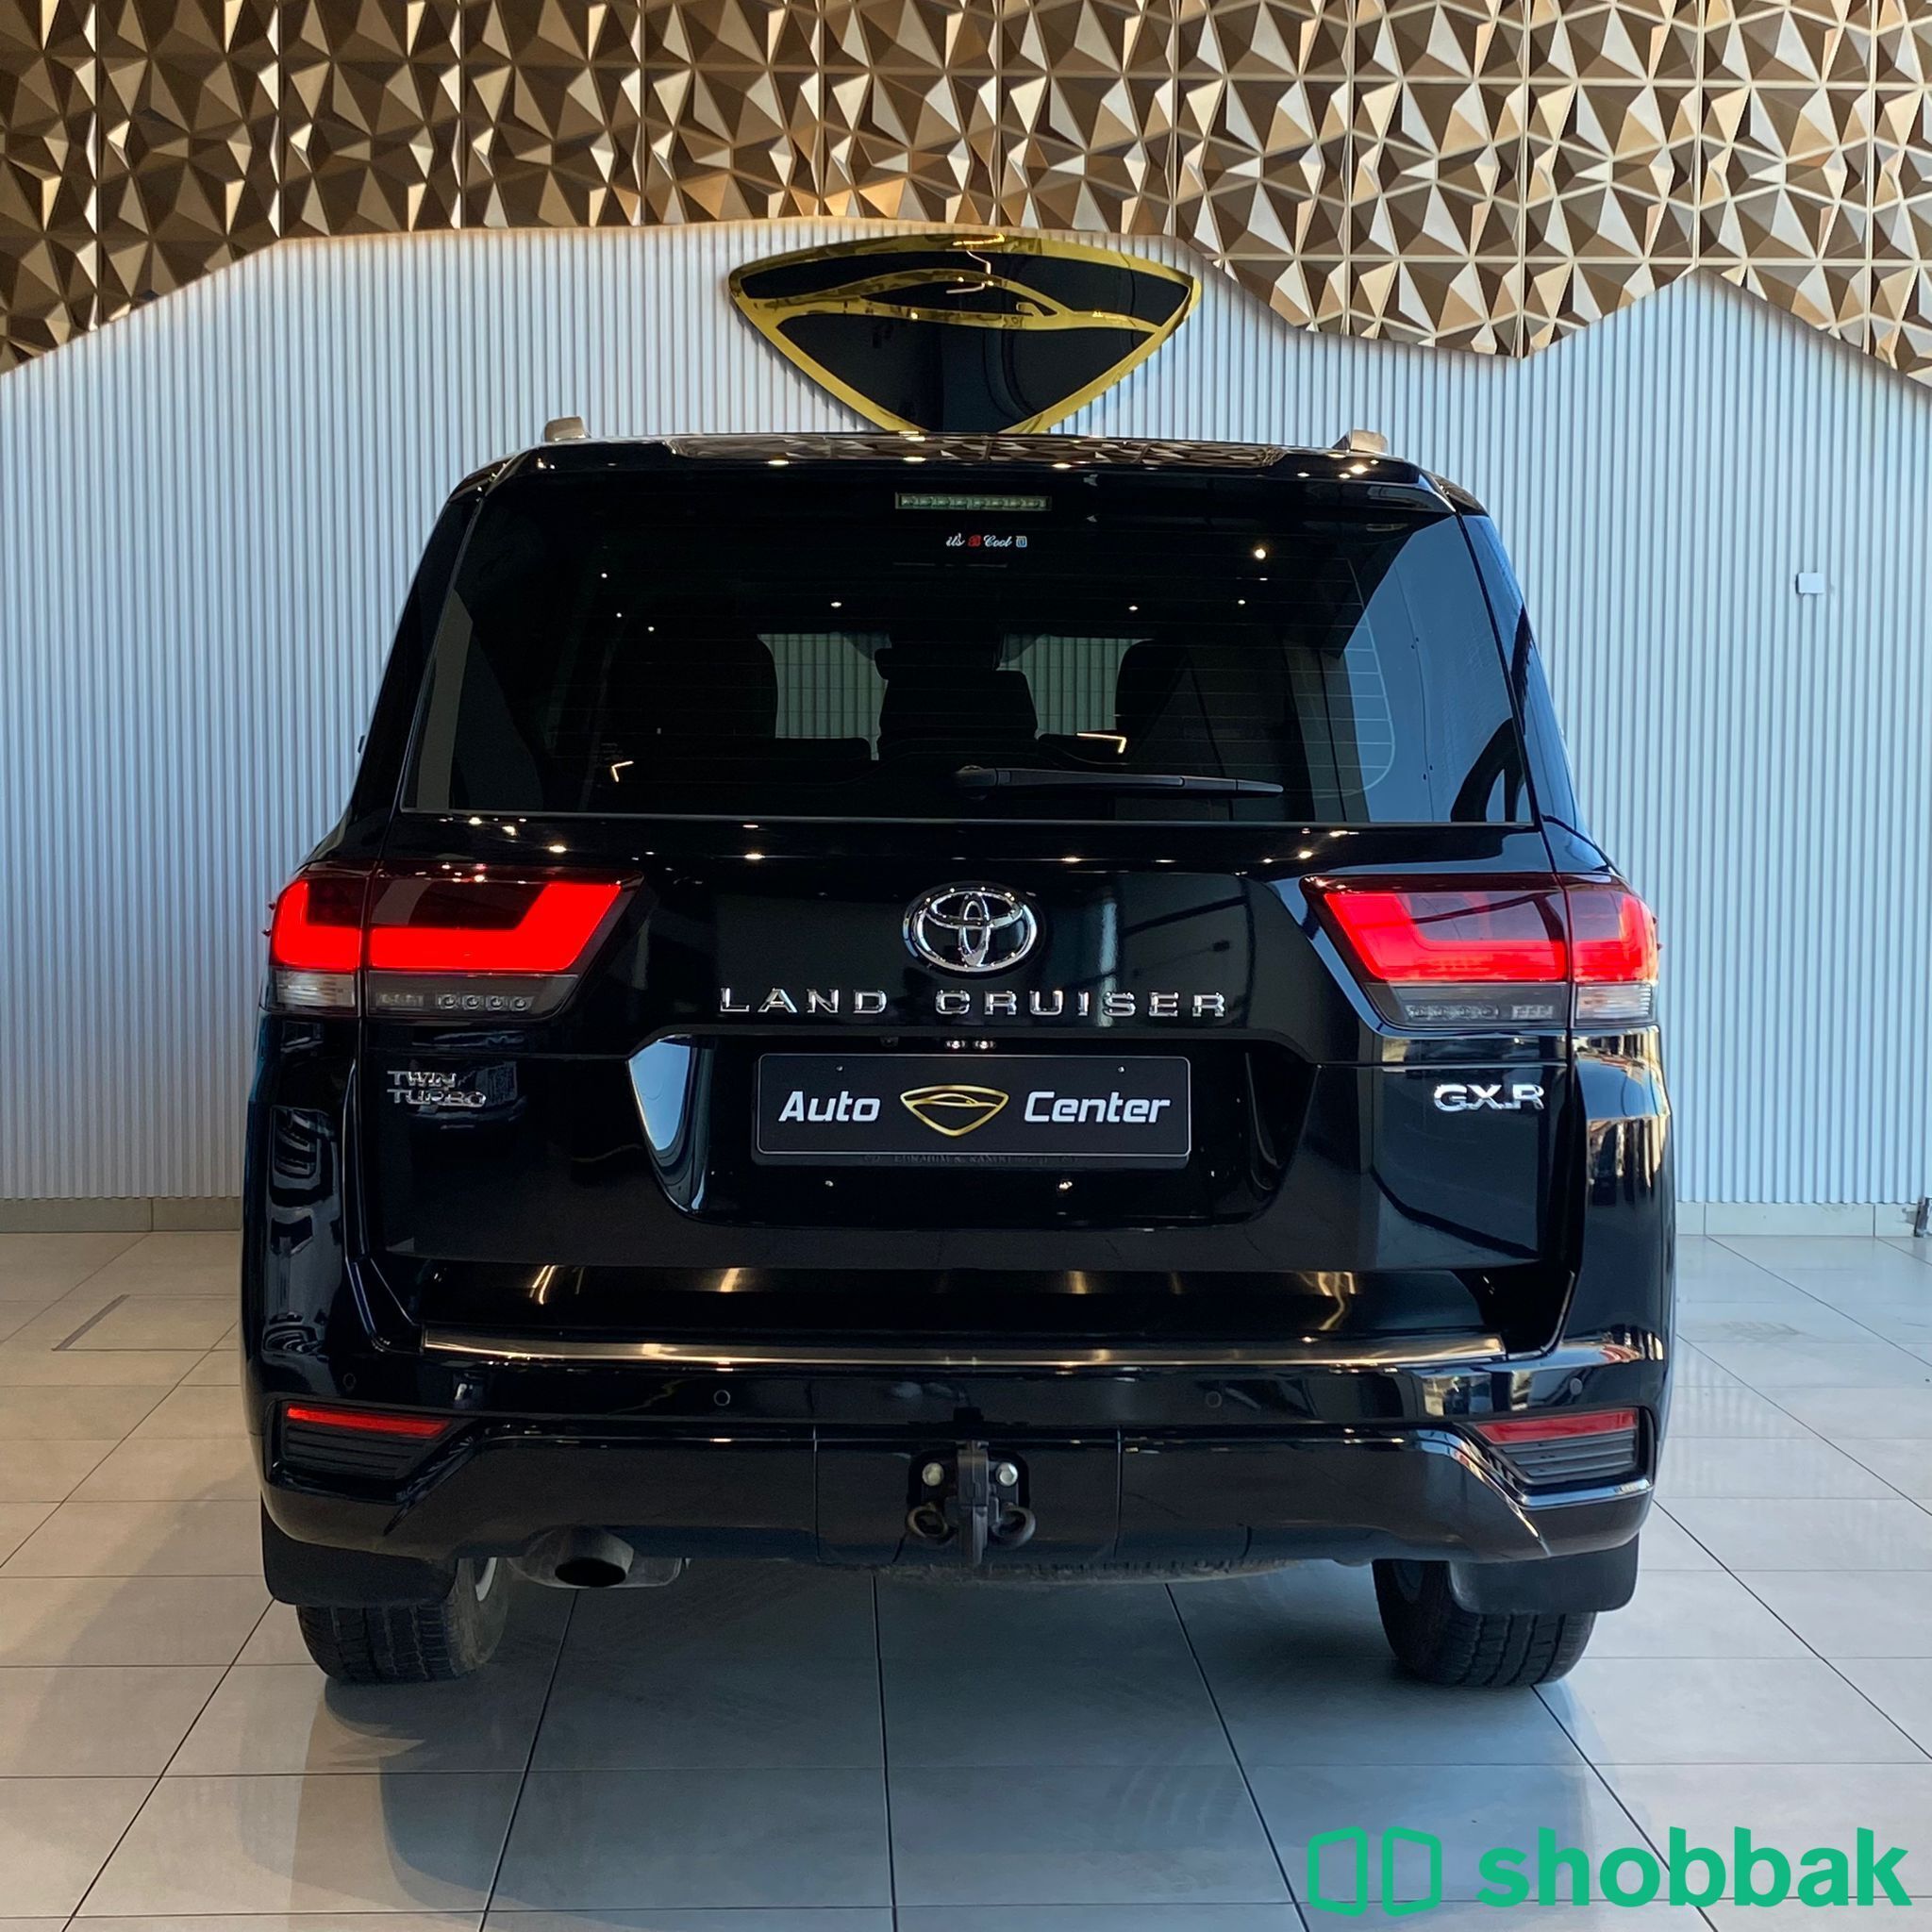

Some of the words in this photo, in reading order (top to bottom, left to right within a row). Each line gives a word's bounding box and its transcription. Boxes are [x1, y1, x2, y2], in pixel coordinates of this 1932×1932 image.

[720, 988, 887, 1014] LAND
[935, 989, 1225, 1017] CRUISER
[387, 1070, 457, 1088] TWIN
[387, 1089, 487, 1108] TURBO
[778, 1091, 881, 1123] Auto
[1024, 1091, 1171, 1124] Center
